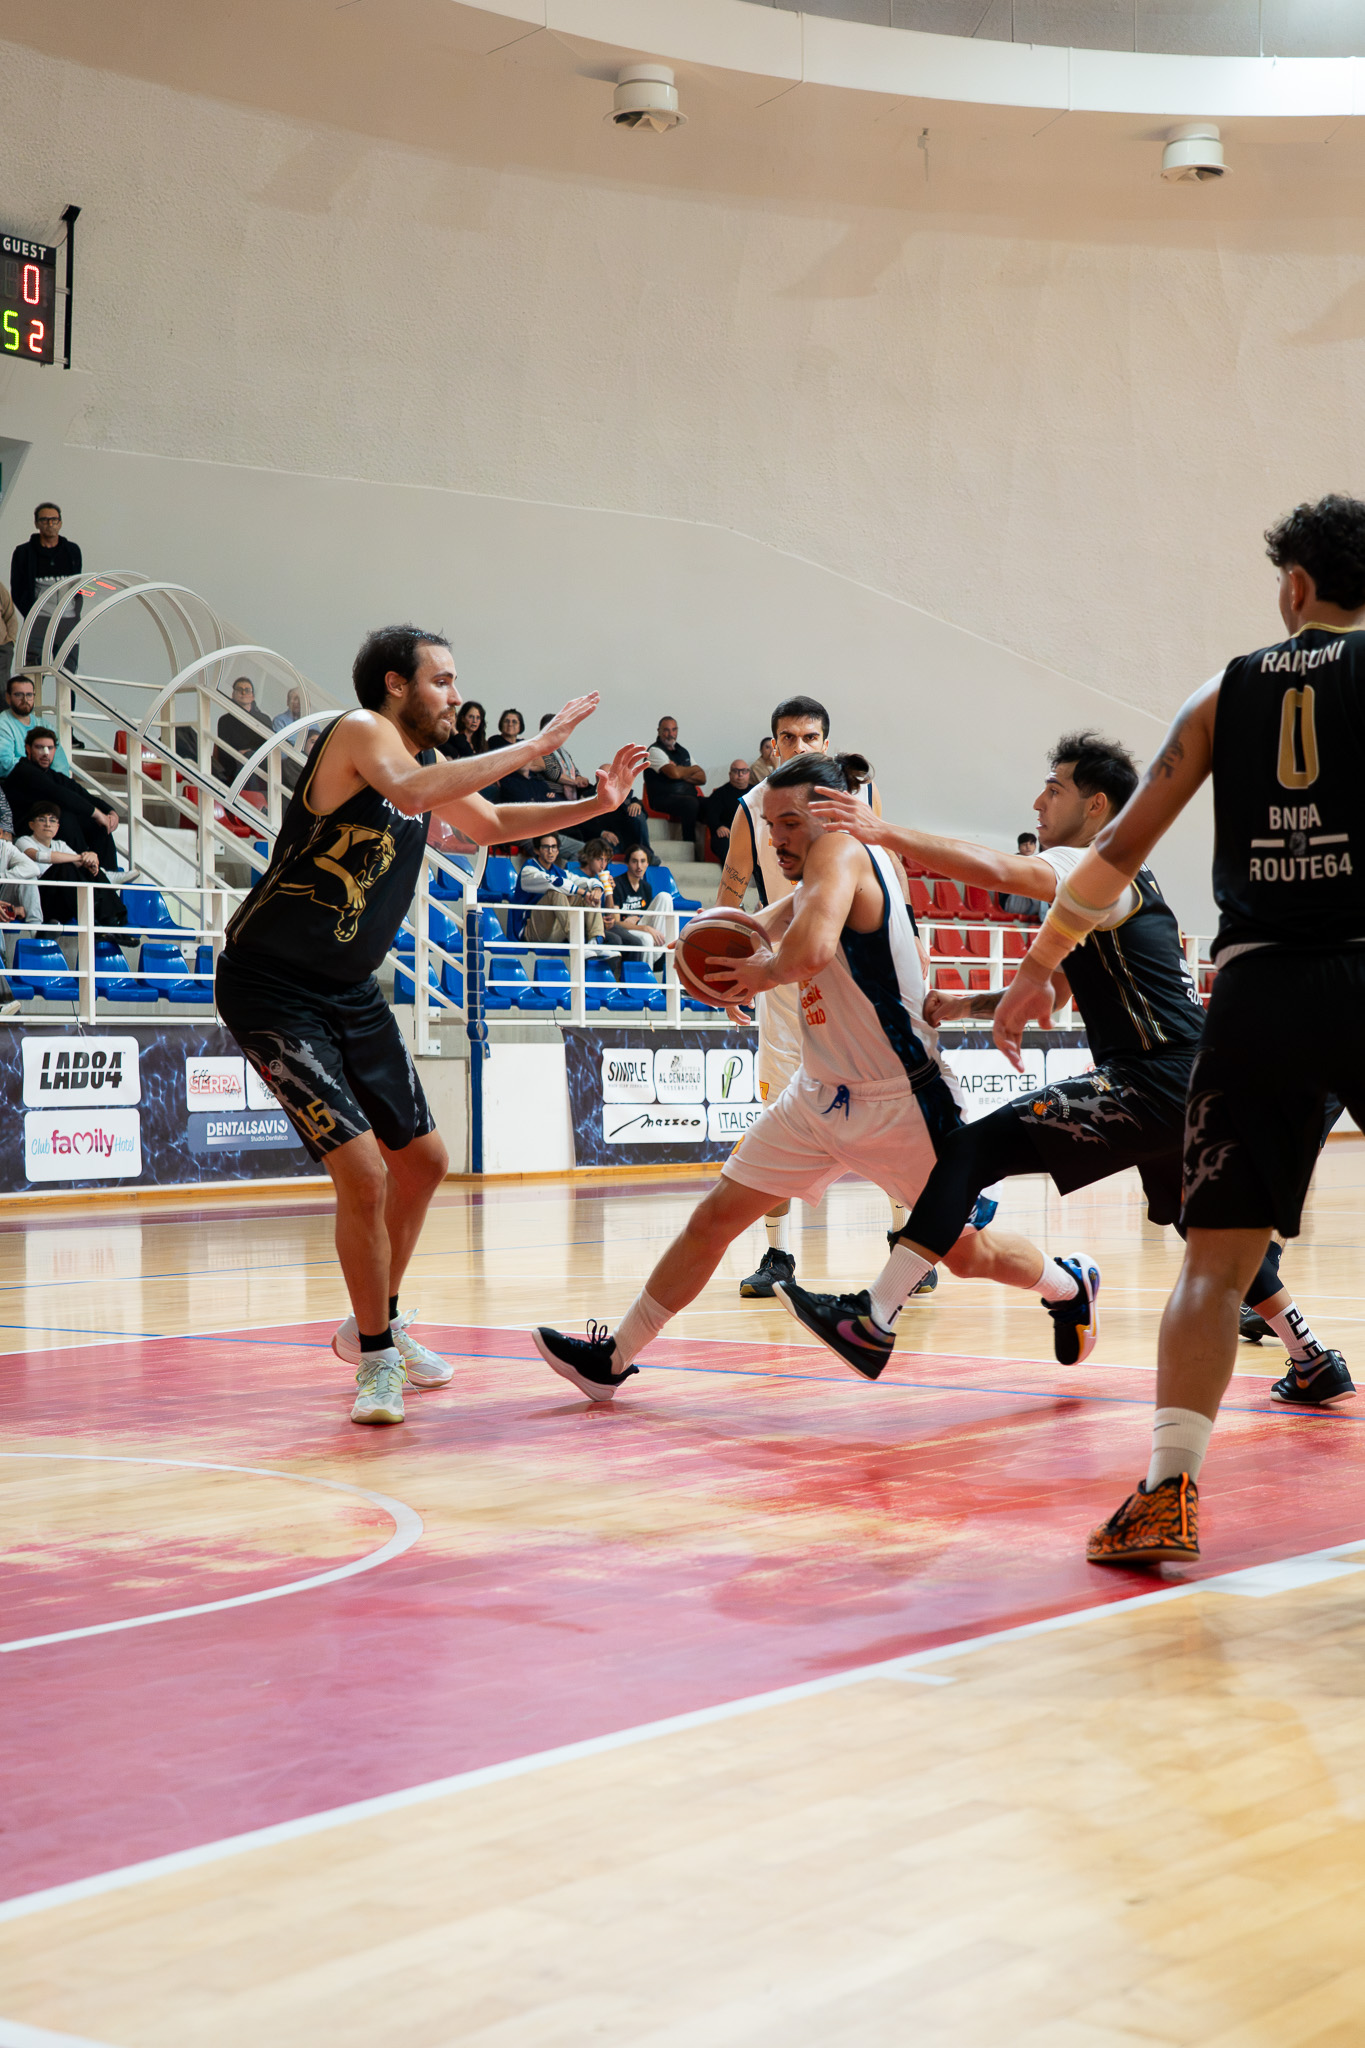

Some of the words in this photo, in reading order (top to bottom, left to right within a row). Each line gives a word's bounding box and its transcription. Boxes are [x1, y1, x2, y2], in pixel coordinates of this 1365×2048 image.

[3, 237, 46, 260] GUEST
[23, 263, 40, 305] 0
[3, 310, 20, 350] 5
[28, 319, 44, 353] 2
[1277, 684, 1319, 790] 0
[1250, 852, 1353, 881] ROUTE64
[189, 1074, 241, 1095] SERRA
[607, 1061, 648, 1082] SIMPLE
[296, 1098, 336, 1142] 15
[31, 1138, 51, 1156] Club
[51, 1128, 115, 1157] family
[115, 1136, 135, 1152] Hotel
